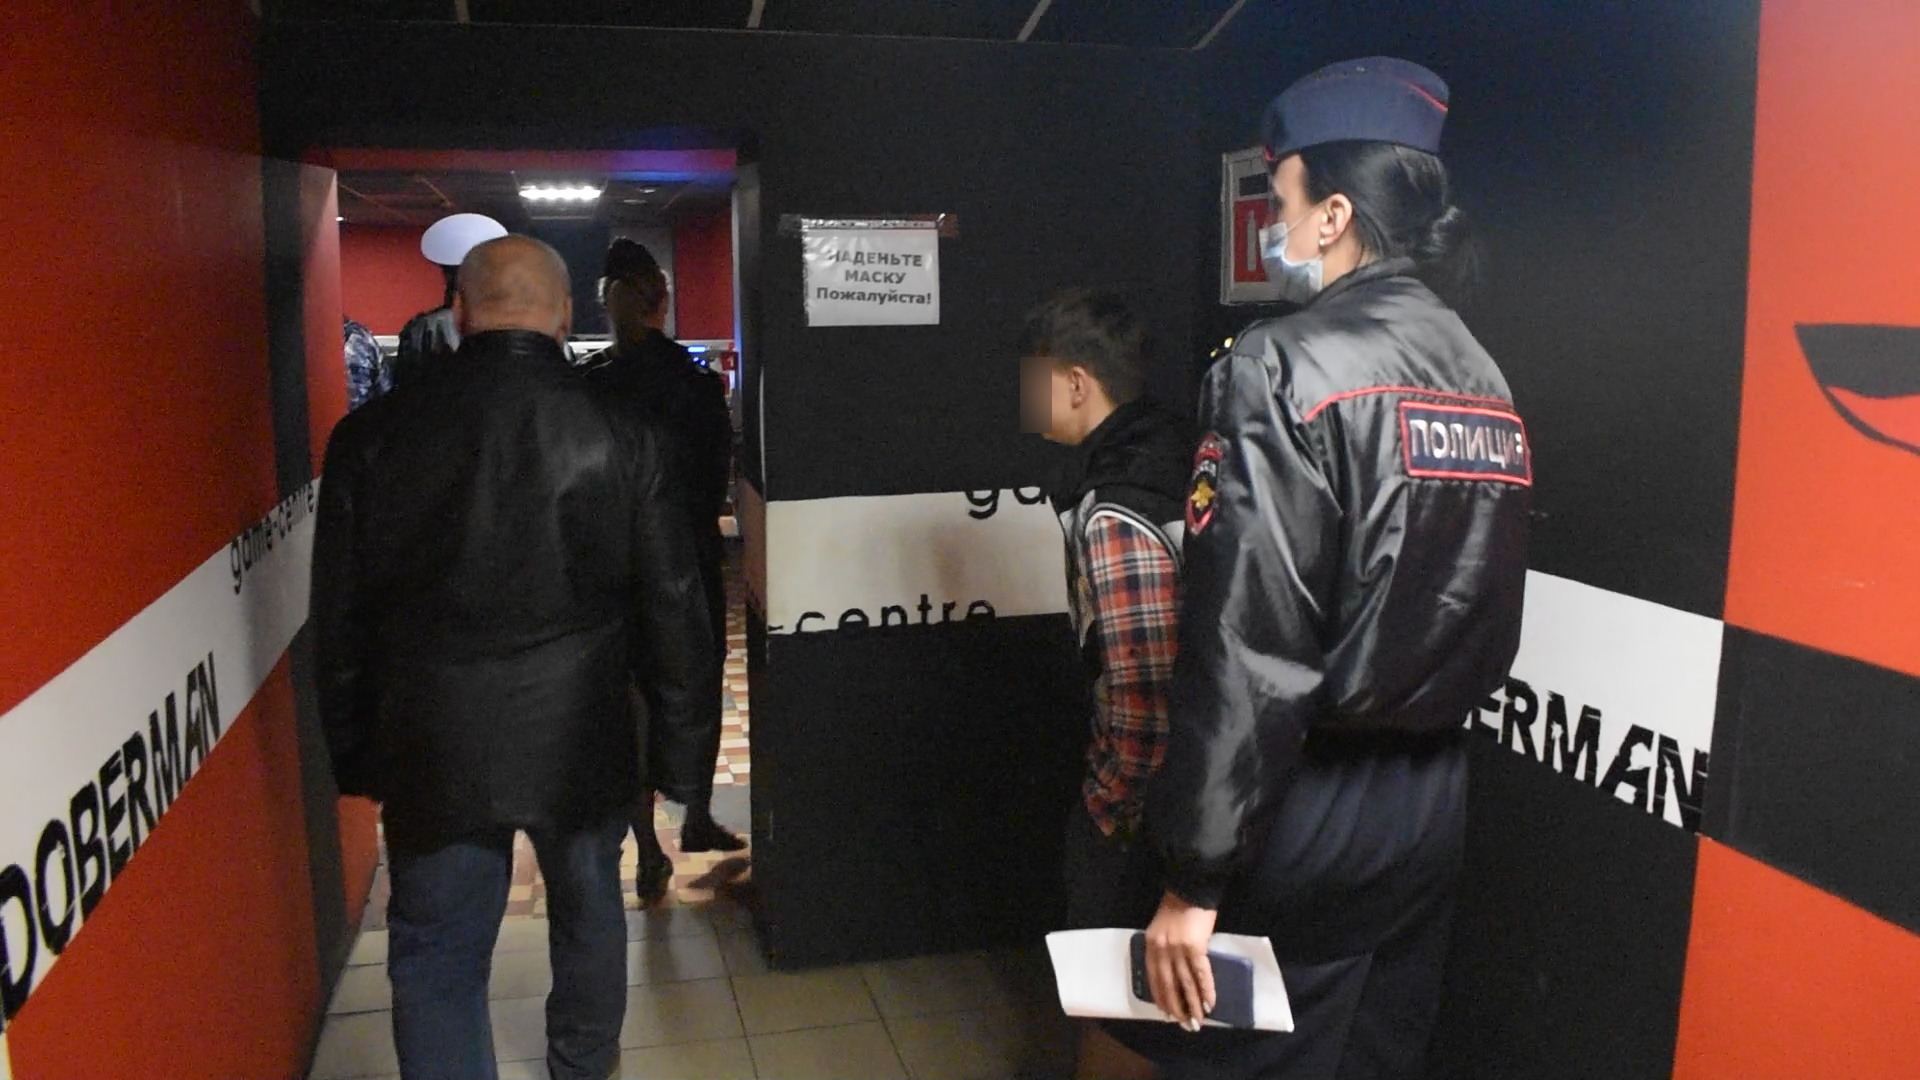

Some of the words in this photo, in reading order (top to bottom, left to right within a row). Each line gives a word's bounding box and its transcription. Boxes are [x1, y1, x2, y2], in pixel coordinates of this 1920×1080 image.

[844, 269, 906, 284] МАСКУ
[816, 287, 932, 305] Пожалуйста!
[0, 650, 221, 1036] DOBERMAN
